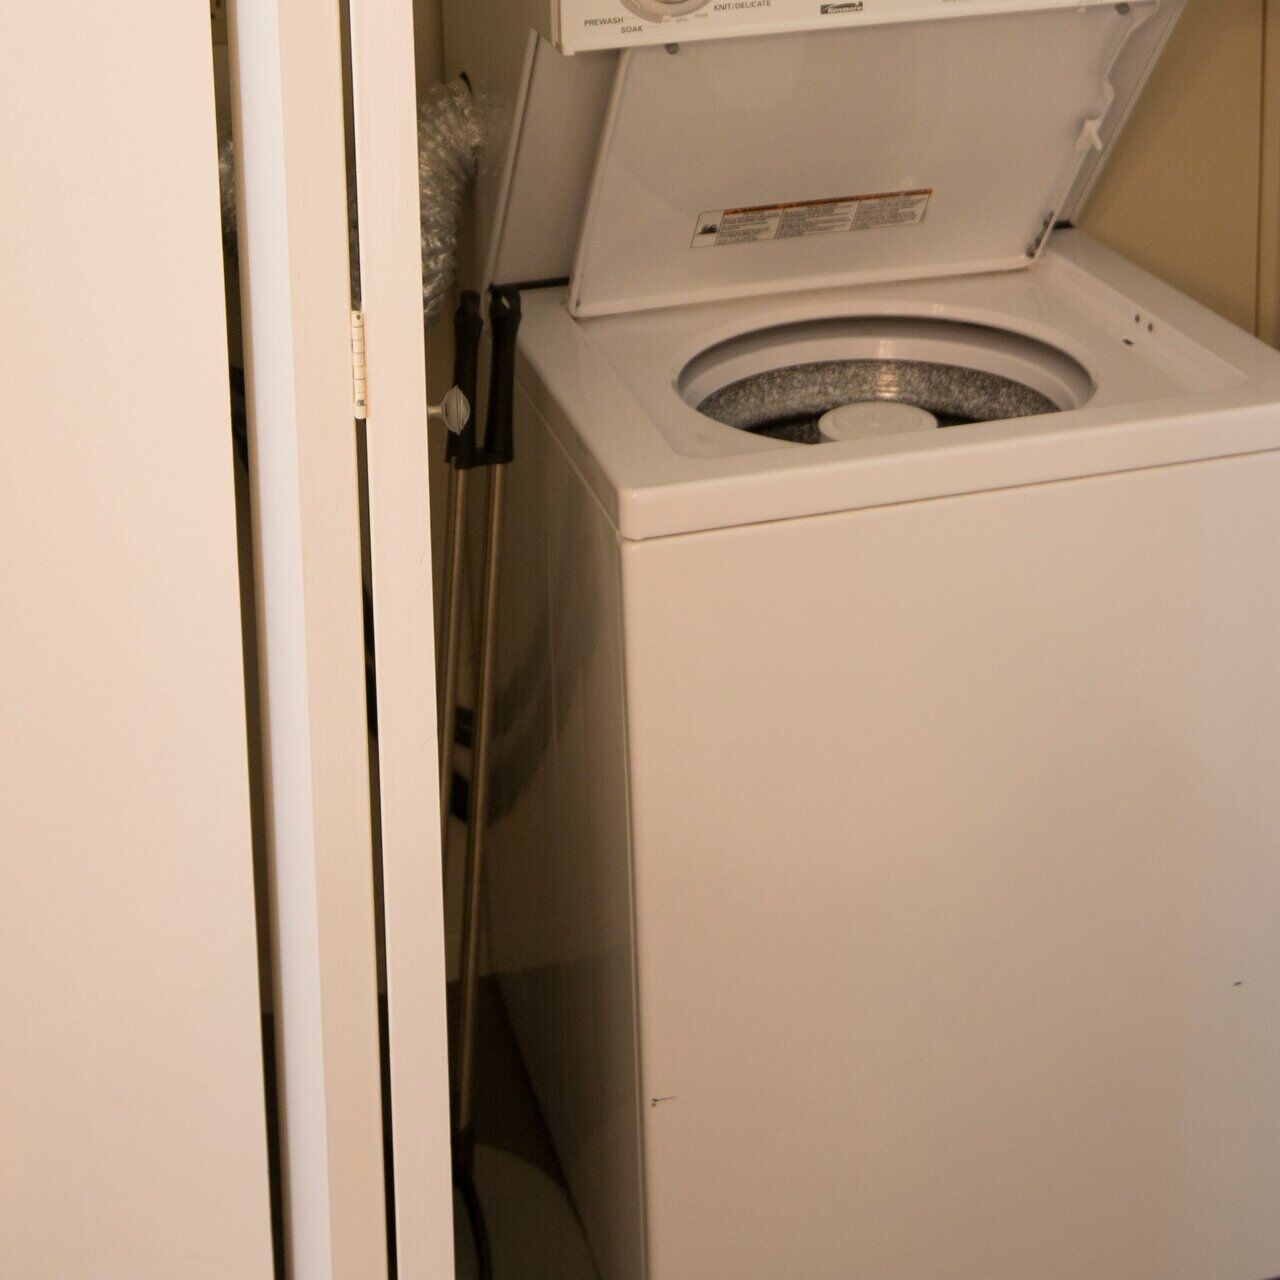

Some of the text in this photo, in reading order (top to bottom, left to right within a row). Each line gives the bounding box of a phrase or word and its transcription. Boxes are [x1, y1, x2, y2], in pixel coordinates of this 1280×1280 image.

[713, 0, 771, 12] KNIT/DELICATE
[825, 4, 863, 14] Kenmore
[584, 17, 623, 27] PREWASH
[620, 24, 643, 33] SOAK
